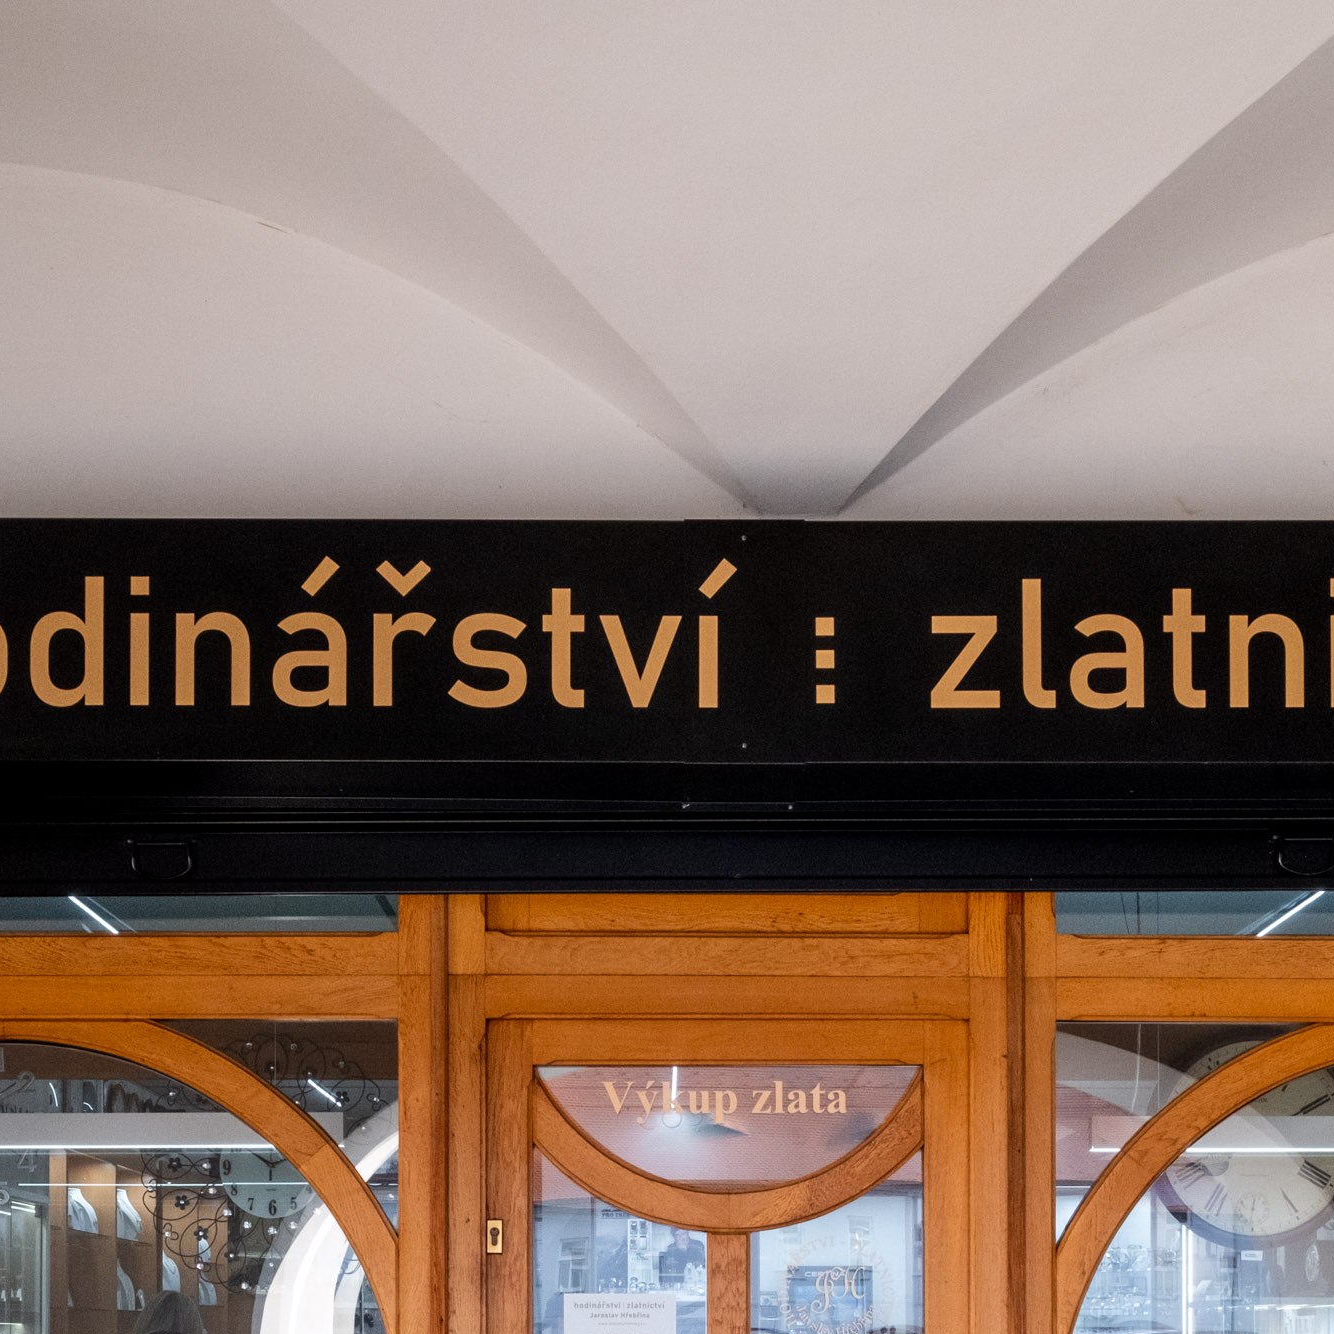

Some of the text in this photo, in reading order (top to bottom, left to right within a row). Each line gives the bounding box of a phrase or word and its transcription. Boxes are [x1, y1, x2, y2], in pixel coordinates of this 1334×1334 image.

[602, 1080, 847, 1124] Výkup zlata
[223, 1160, 231, 1175] 9
[230, 1184, 238, 1196] 8
[247, 1197, 255, 1211] 7
[268, 1199, 277, 1216] 6
[290, 1196, 298, 1210] 5
[574, 1301, 621, 1309] hodinářství
